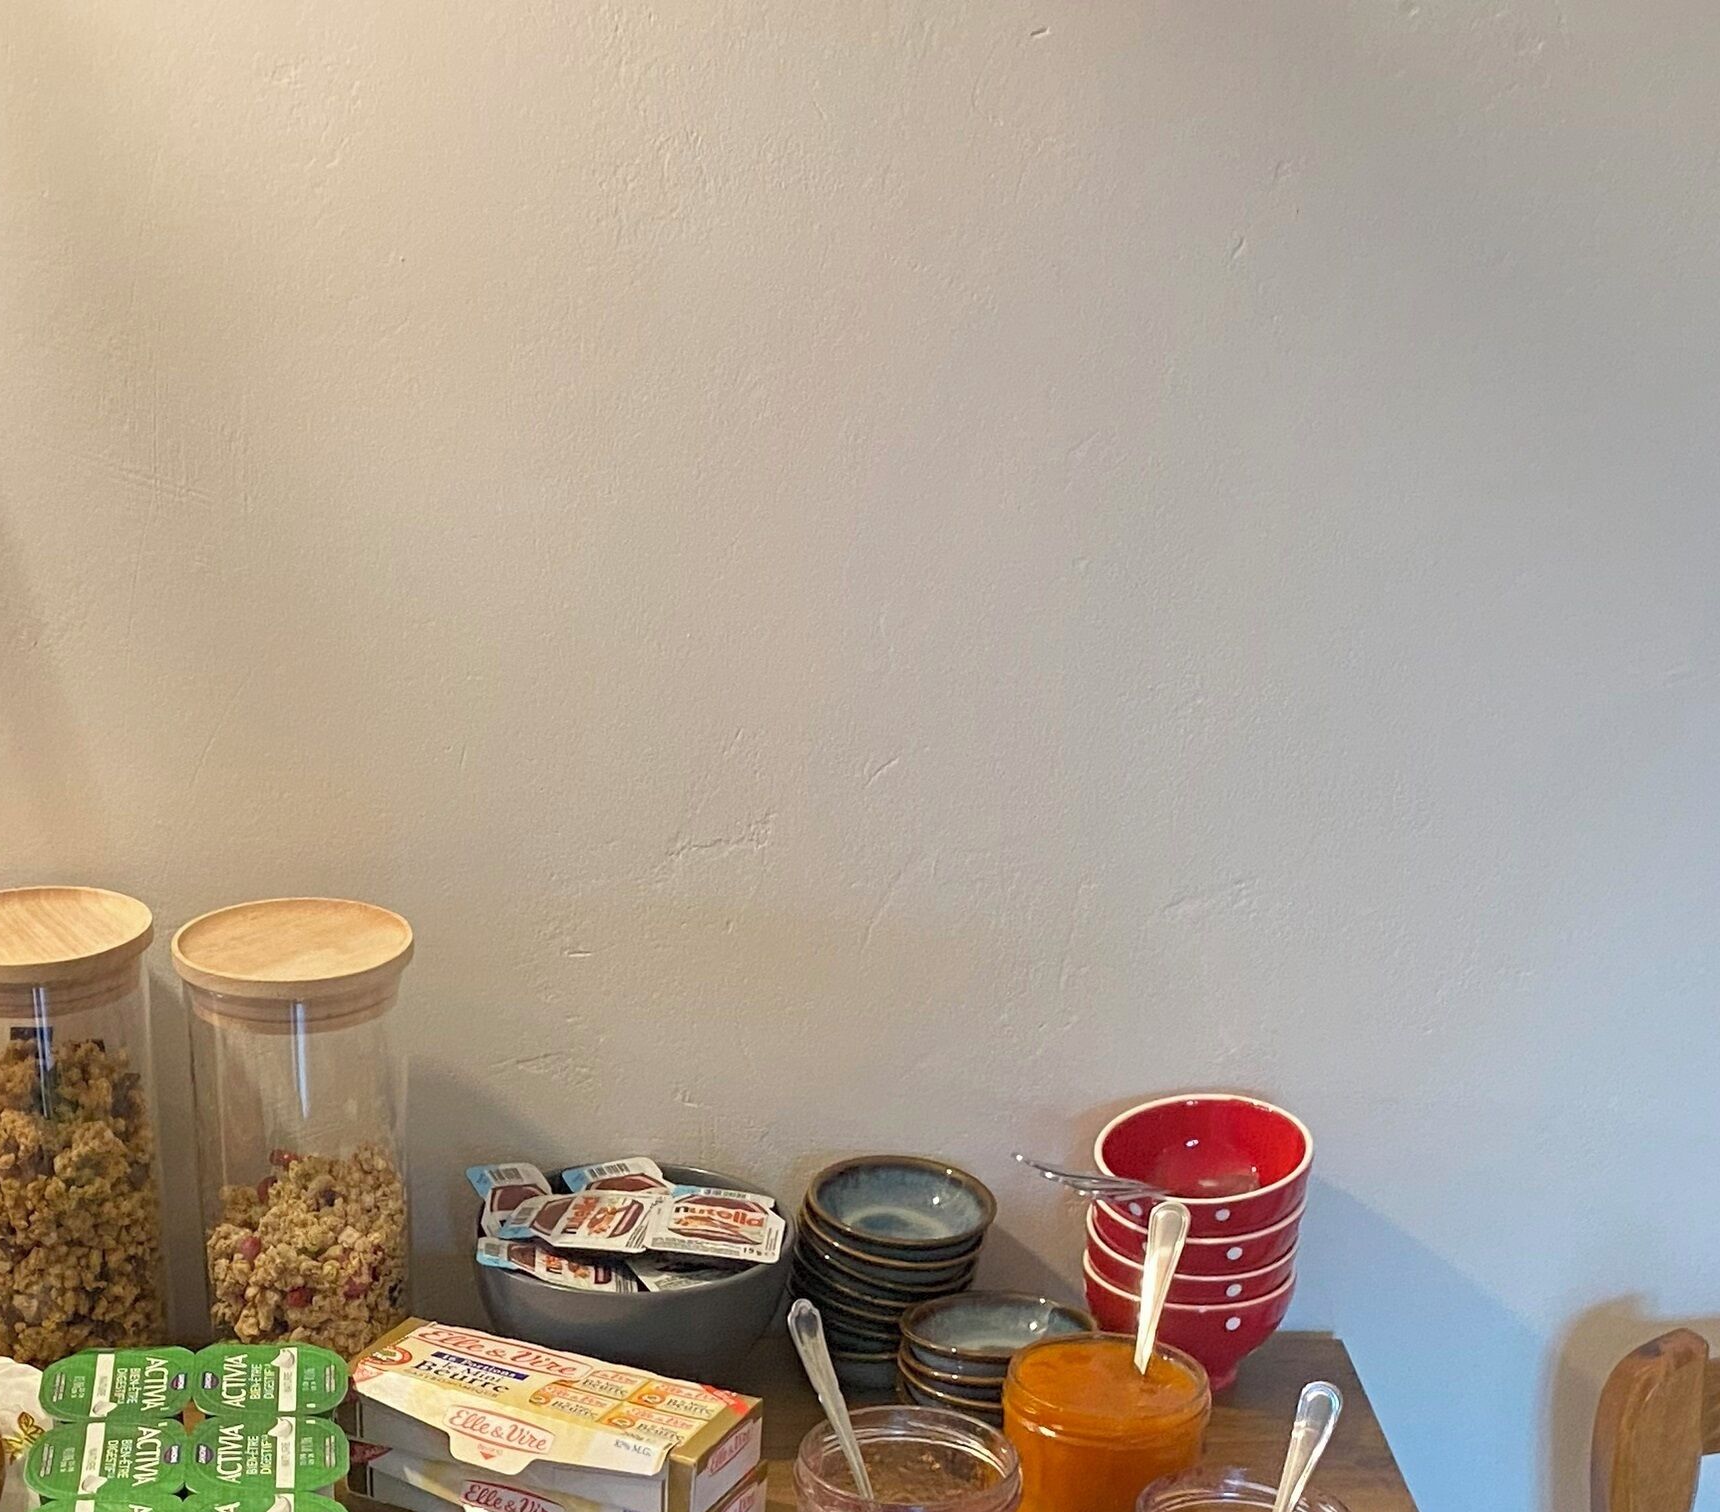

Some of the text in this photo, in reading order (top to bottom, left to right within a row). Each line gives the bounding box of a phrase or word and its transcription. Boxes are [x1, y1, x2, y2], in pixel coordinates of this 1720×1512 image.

[414, 1360, 510, 1393] Beurre
[418, 1330, 578, 1377] Elle & Vire
[141, 1357, 169, 1411] ACTIVIA
[222, 1354, 248, 1408] ACTIVIA
[216, 1425, 244, 1484] ACTIVIA
[449, 1409, 490, 1435] Elle
[491, 1426, 504, 1440] &
[506, 1424, 547, 1450] Vire
[130, 1426, 161, 1487] ACTIVIA
[463, 1484, 502, 1510] Elle
[504, 1499, 517, 1512] &
